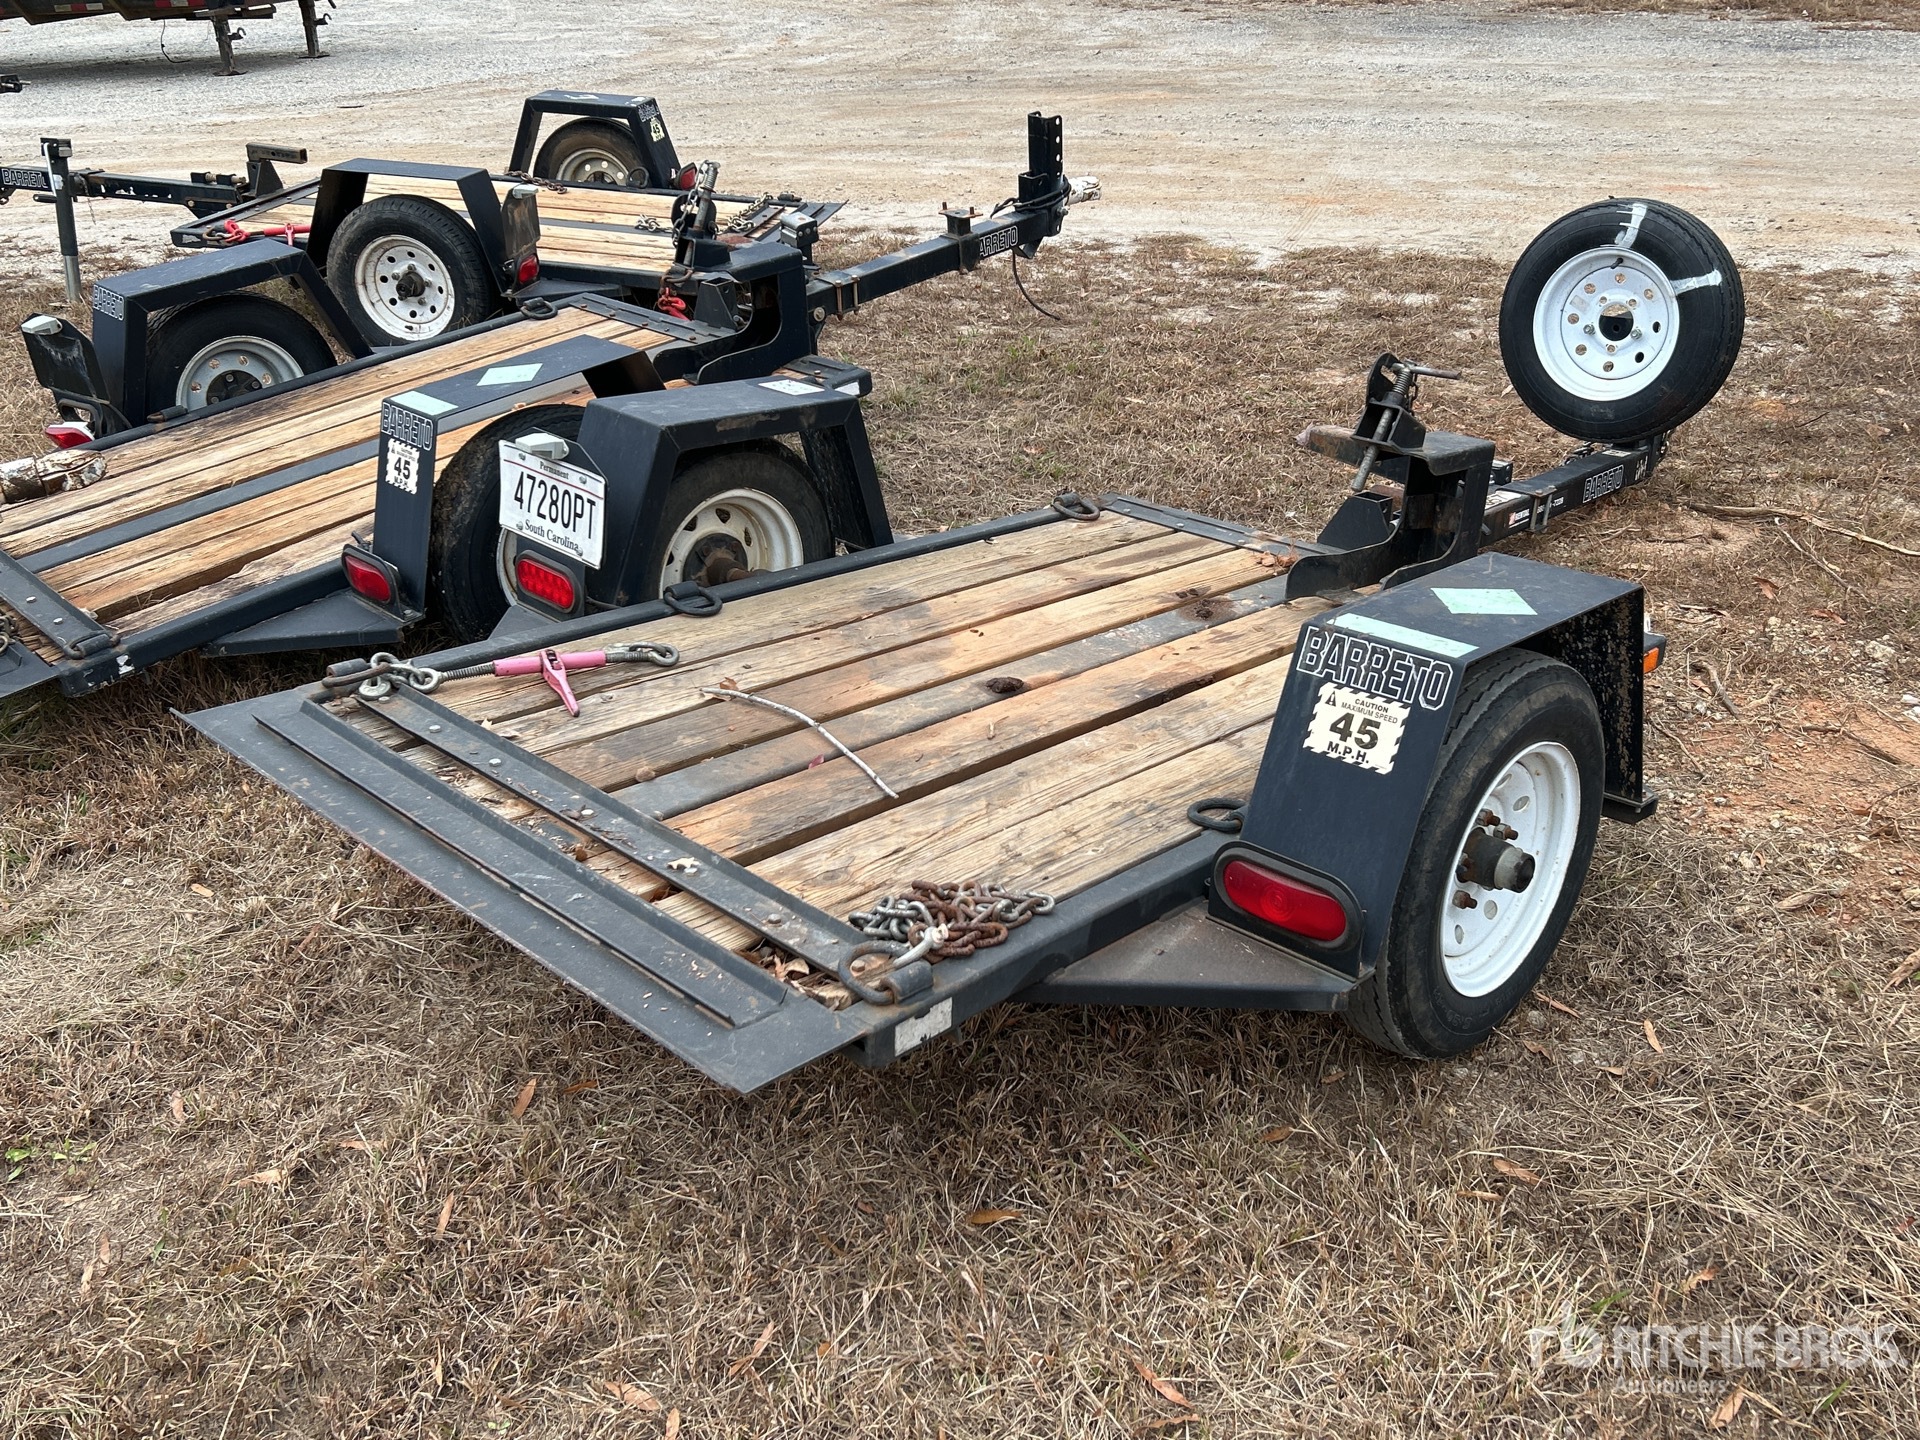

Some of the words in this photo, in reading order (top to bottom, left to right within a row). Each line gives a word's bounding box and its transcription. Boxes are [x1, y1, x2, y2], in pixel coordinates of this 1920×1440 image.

[381, 402, 434, 452] BARRETO
[394, 457, 411, 480] 45
[539, 460, 570, 480] Permanent
[1582, 464, 1625, 504] BARRETO
[513, 470, 597, 540] 47280PT
[524, 518, 545, 538] South
[546, 529, 580, 552] Carolina
[1296, 625, 1454, 711] BARRETO
[1340, 701, 1374, 717] MAXIMUM
[1374, 711, 1398, 724] SPEED
[1354, 698, 1389, 714] CAUTION
[1329, 712, 1382, 750] 45
[1327, 741, 1370, 764] M.P.H.
